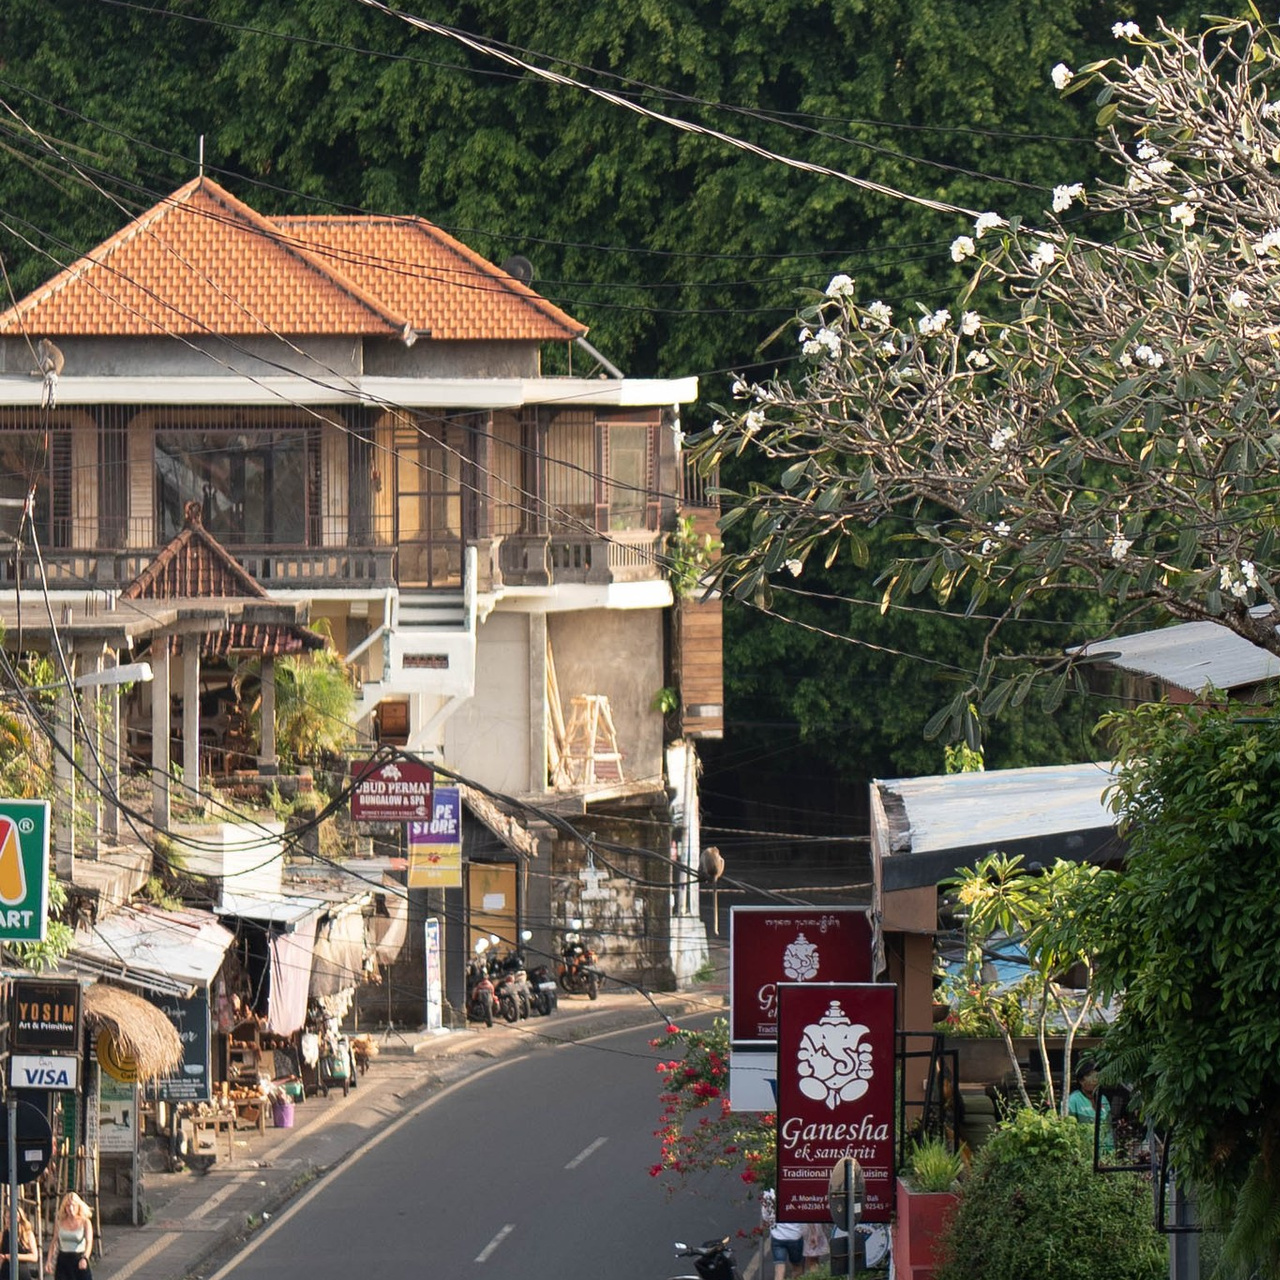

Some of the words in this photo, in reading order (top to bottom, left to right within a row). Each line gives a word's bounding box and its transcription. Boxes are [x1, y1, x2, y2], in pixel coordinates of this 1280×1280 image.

[388, 782, 431, 795] PERMAI
[360, 795, 402, 806] BUNGALOW
[403, 796, 409, 806] &
[410, 795, 425, 806] SPA
[413, 819, 457, 834] STORE
[20, 1002, 74, 1022] YOSIM
[19, 1021, 31, 1030] Art
[32, 1022, 39, 1030] &
[41, 1023, 73, 1031] Primitive
[24, 1069, 68, 1085] VISA
[782, 1114, 889, 1149] Ganesha
[795, 1143, 814, 1162] ek
[814, 1143, 877, 1159] sanskriti
[783, 1168, 828, 1178] Traditional
